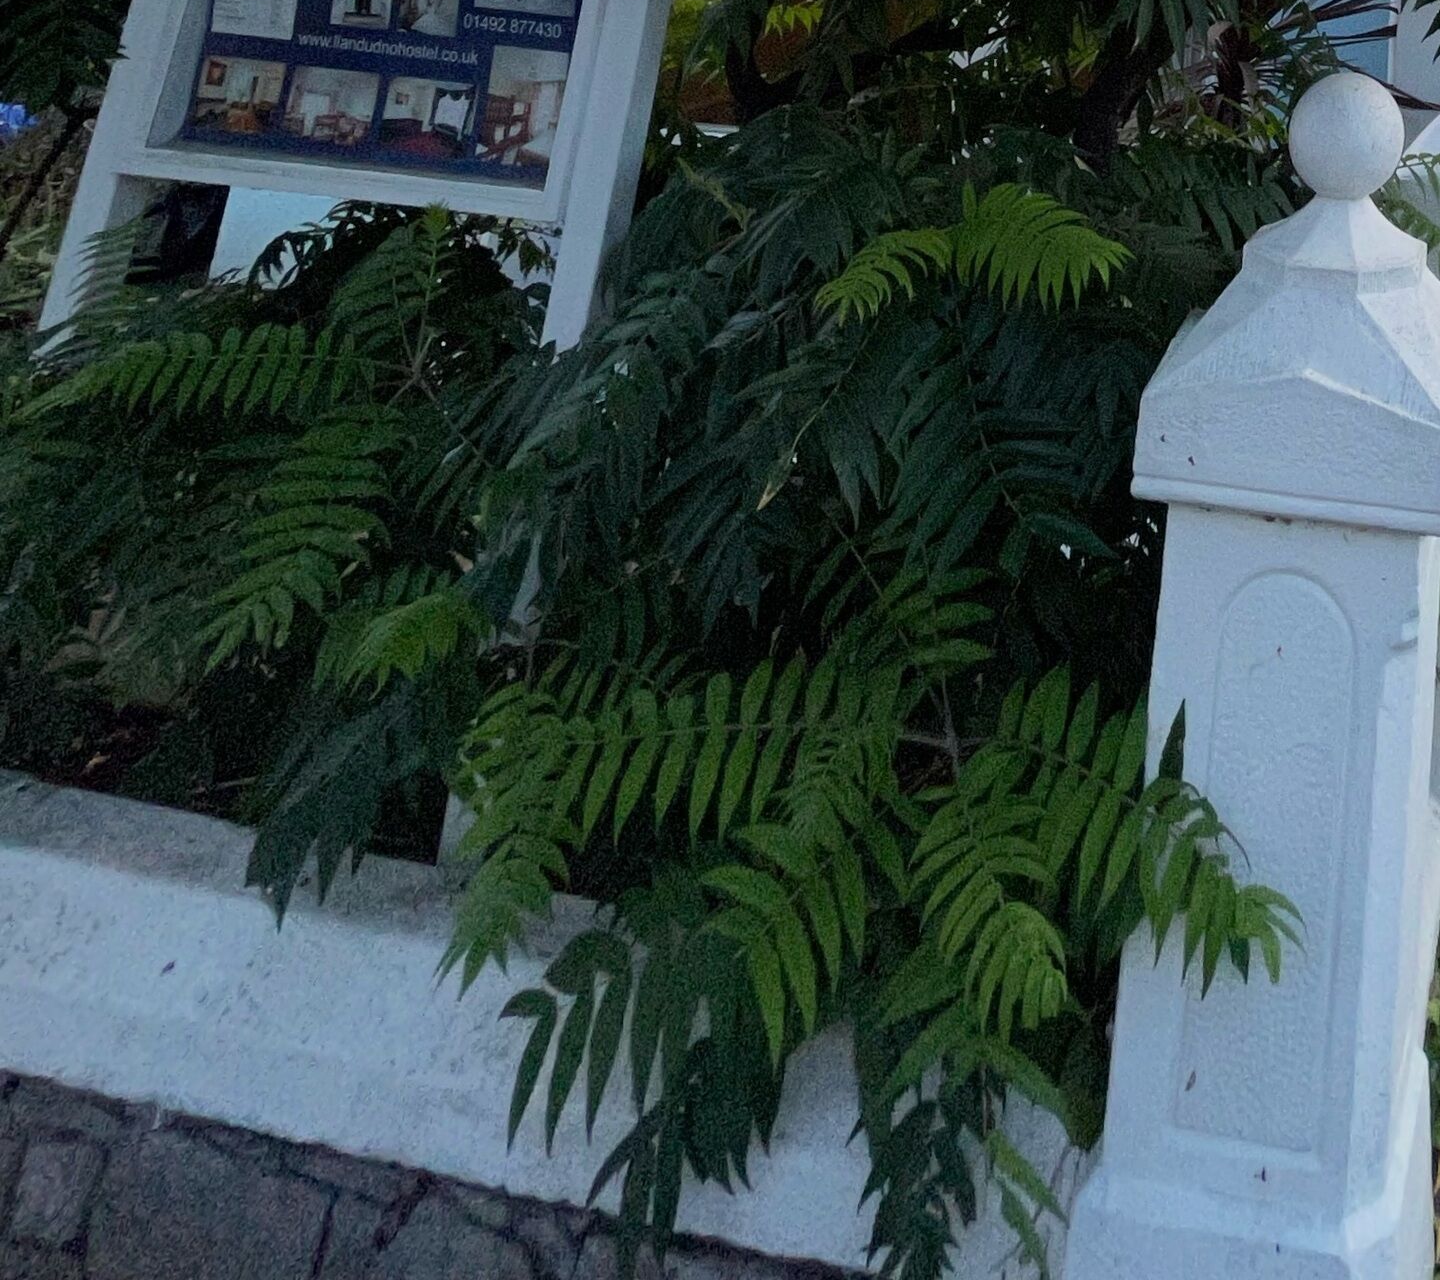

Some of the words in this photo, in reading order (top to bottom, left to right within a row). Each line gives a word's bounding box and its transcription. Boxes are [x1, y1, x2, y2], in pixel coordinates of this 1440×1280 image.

[463, 12, 506, 32] 01492
[510, 19, 562, 39] 877430
[297, 33, 479, 66] www.llandudnohostel.co.uk
